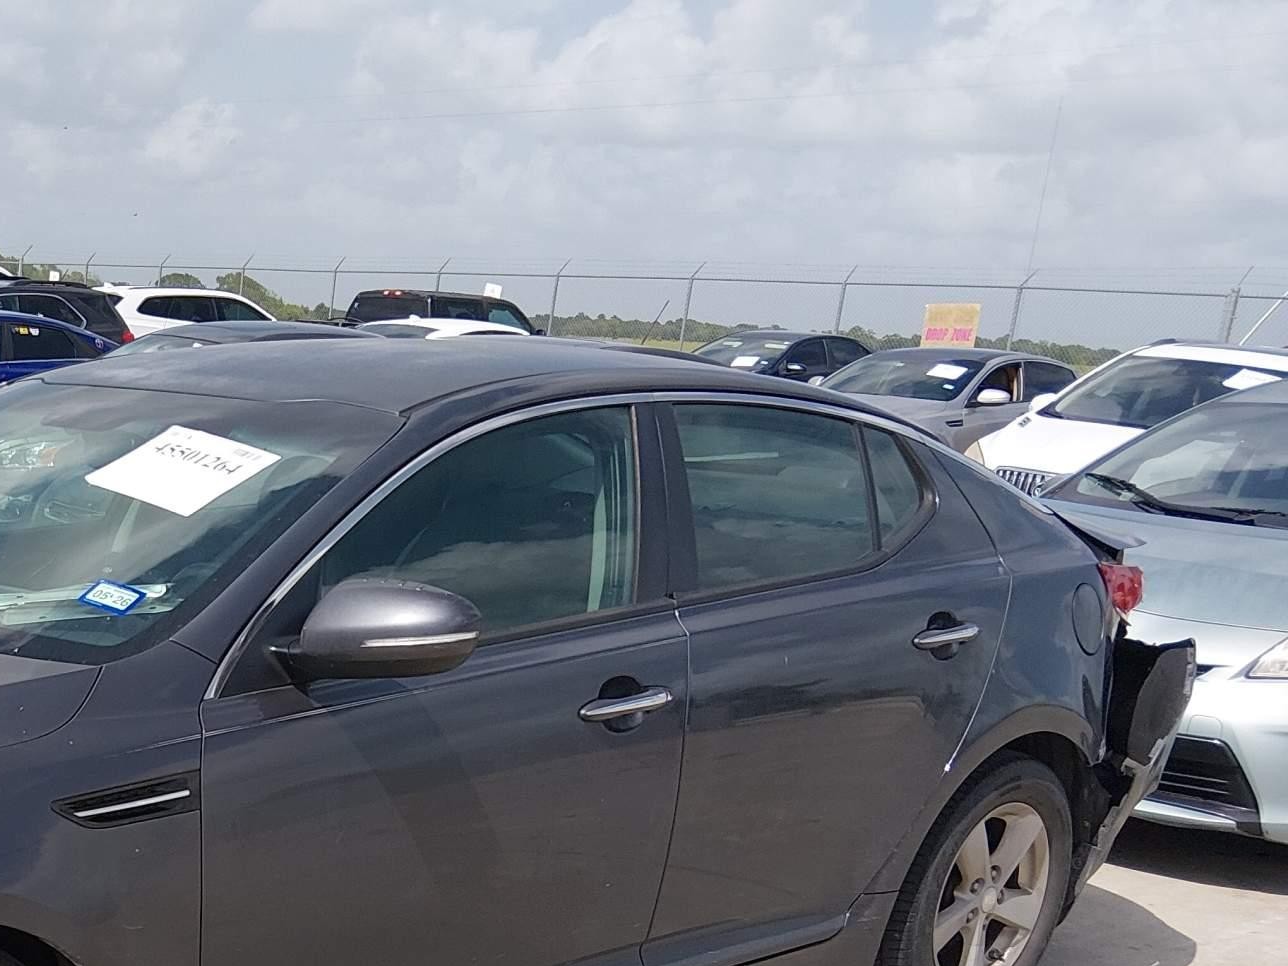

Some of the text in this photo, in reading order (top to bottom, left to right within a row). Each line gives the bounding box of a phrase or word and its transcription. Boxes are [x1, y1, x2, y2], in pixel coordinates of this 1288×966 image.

[925, 327, 974, 342] DROP ZONE
[155, 443, 243, 475] 45501264
